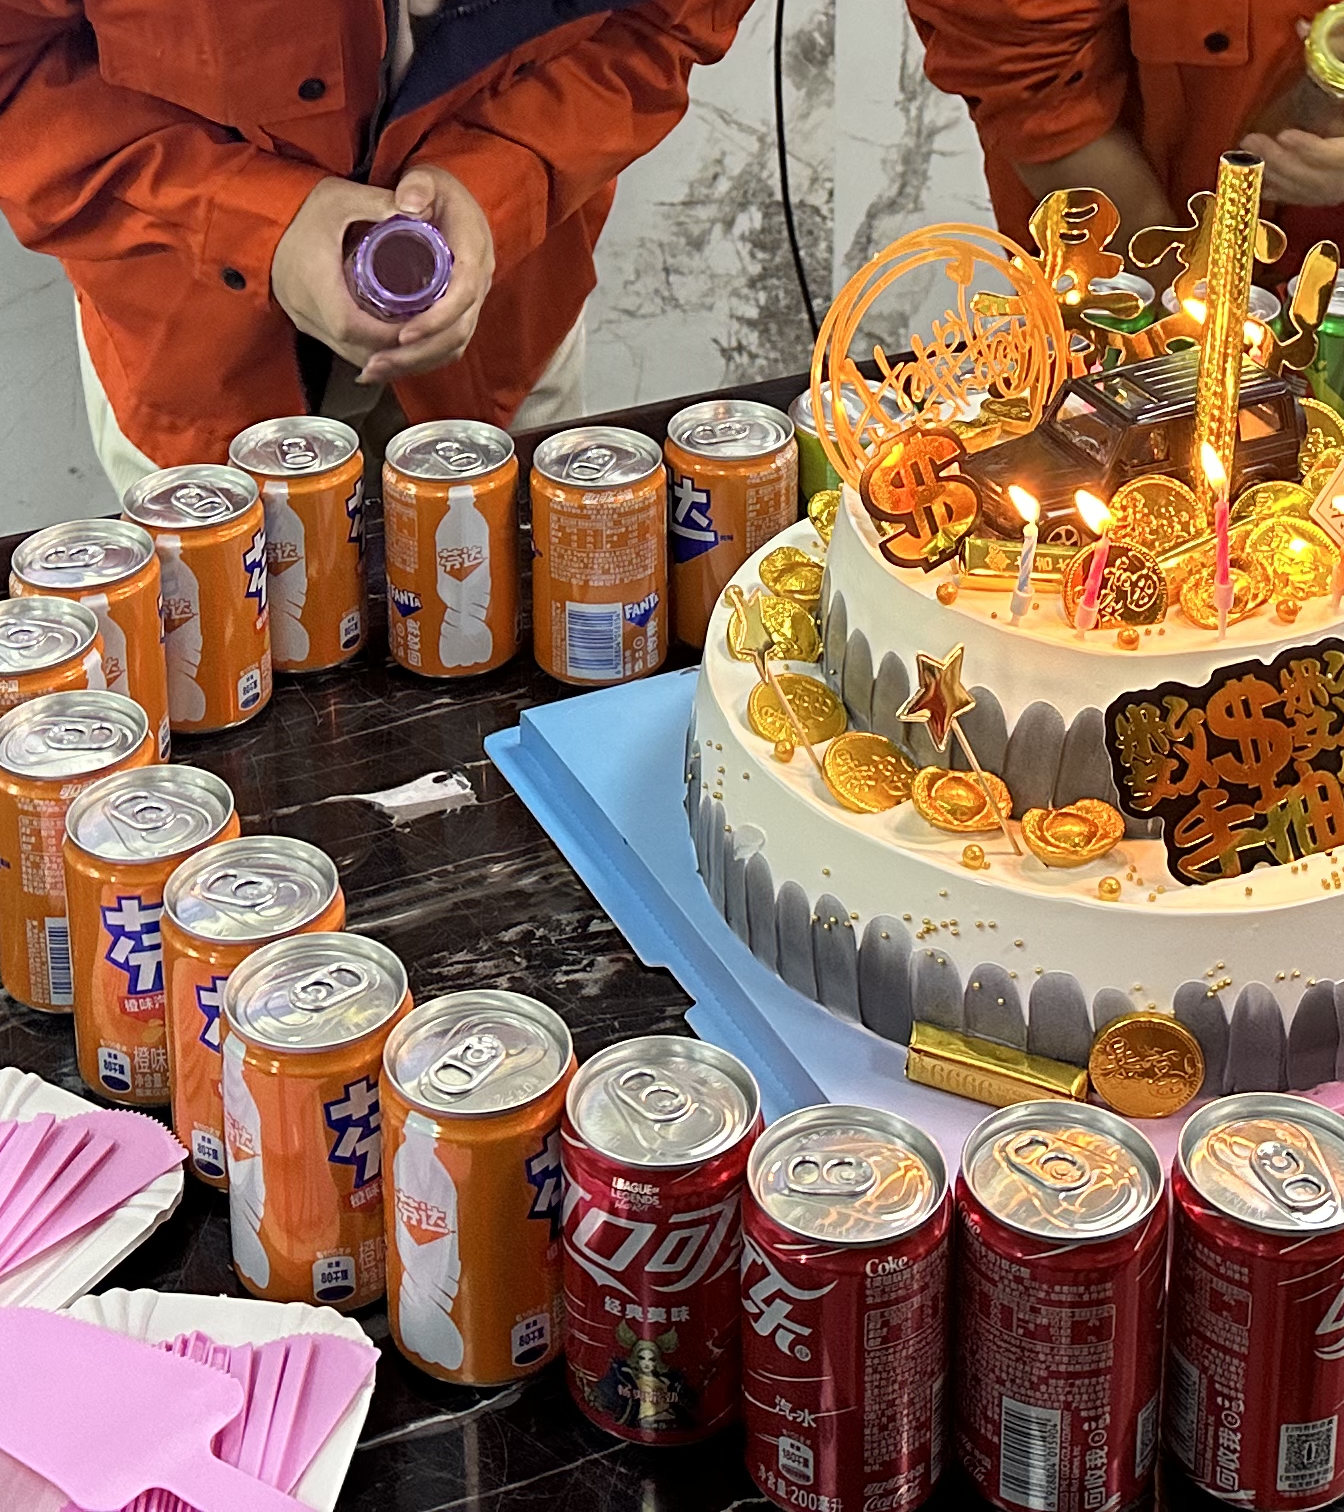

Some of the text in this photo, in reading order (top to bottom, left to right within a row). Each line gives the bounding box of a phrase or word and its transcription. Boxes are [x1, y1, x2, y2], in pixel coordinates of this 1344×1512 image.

[437, 545, 486, 573] 芬达
[611, 1189, 660, 1206] LEGENDS
[612, 1176, 653, 1196] LEAGUE
[864, 1255, 908, 1278] Coke
[604, 1296, 691, 1324] 经典美味
[775, 1394, 817, 1428] 汽水
[1216, 1427, 1242, 1491] 回收我
[1084, 1445, 1108, 1509] 回收我
